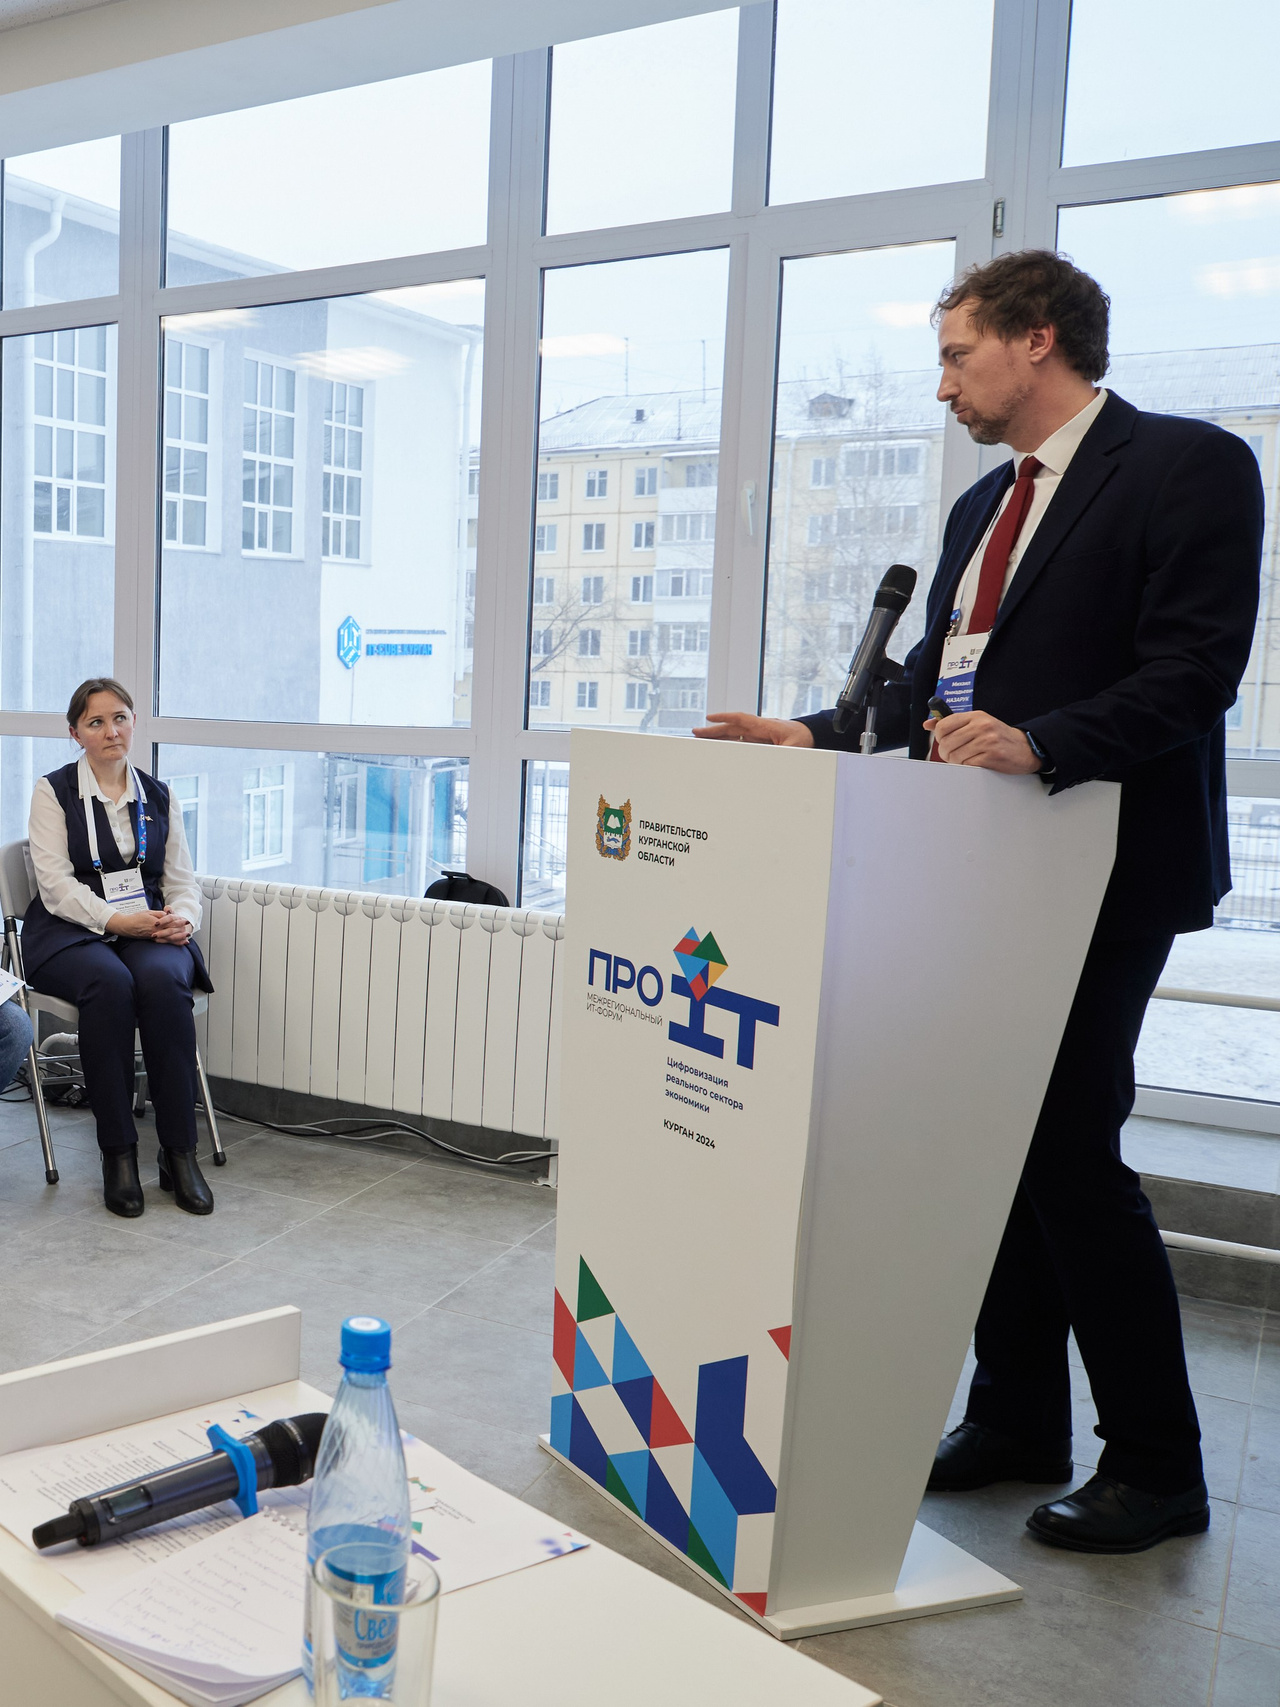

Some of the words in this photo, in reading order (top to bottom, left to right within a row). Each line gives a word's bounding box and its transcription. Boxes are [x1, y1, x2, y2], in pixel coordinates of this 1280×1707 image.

[639, 819, 709, 841] ПРАВИТЕЛЬСТВО
[637, 850, 675, 867] ОБЛАСТИ
[638, 835, 690, 854] КУРГАНСКОЙ
[586, 992, 663, 1026] МЕЖРЕГИОНАЛЬНЫЙ
[586, 1003, 623, 1022] ИТ-ФОРУМ
[588, 947, 664, 1007] ПРО
[668, 973, 781, 1071] IT
[666, 1056, 729, 1088] Цифровизация
[664, 1088, 710, 1113] экономики
[665, 1073, 708, 1096] реального
[709, 1090, 744, 1110] сектора
[663, 1118, 695, 1140] КУРГАН
[695, 1132, 716, 1149] 2024
